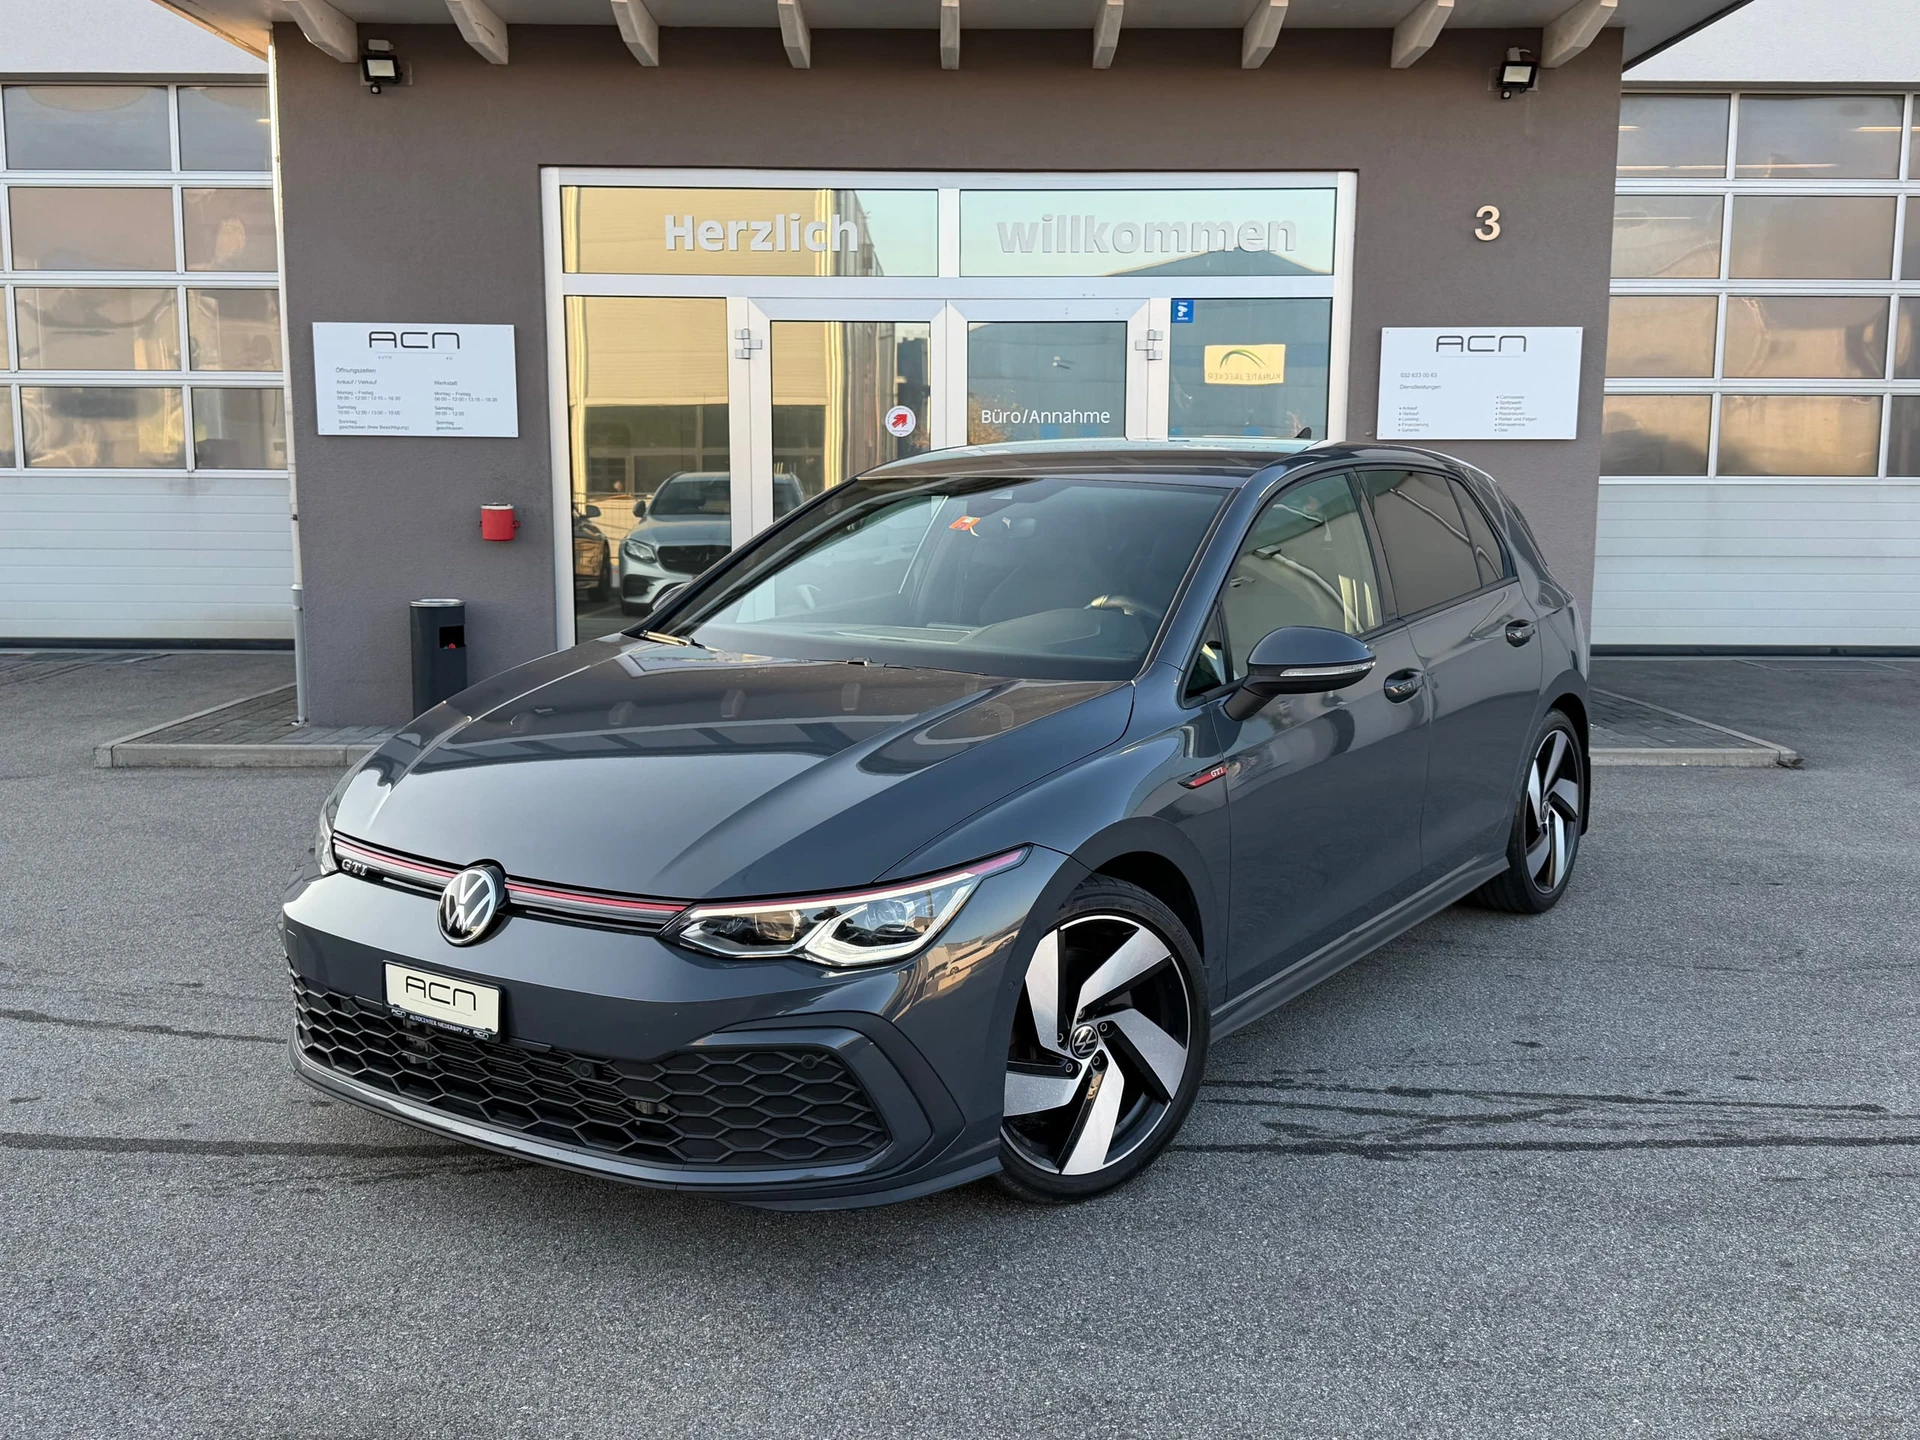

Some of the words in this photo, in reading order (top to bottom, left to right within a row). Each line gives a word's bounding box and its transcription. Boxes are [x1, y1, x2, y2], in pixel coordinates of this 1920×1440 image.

[1474, 205, 1500, 240] 3
[664, 213, 858, 251] Herzlich
[997, 214, 1296, 252] willkommen
[336, 366, 376, 374] Öffnungszeiten
[981, 409, 1110, 424] Büro/Annahme
[1210, 767, 1223, 777] GTI
[341, 858, 368, 876] GTI
[409, 1014, 437, 1026] AUTOCENTER
[438, 1022, 463, 1033] NIEDERBIPP
